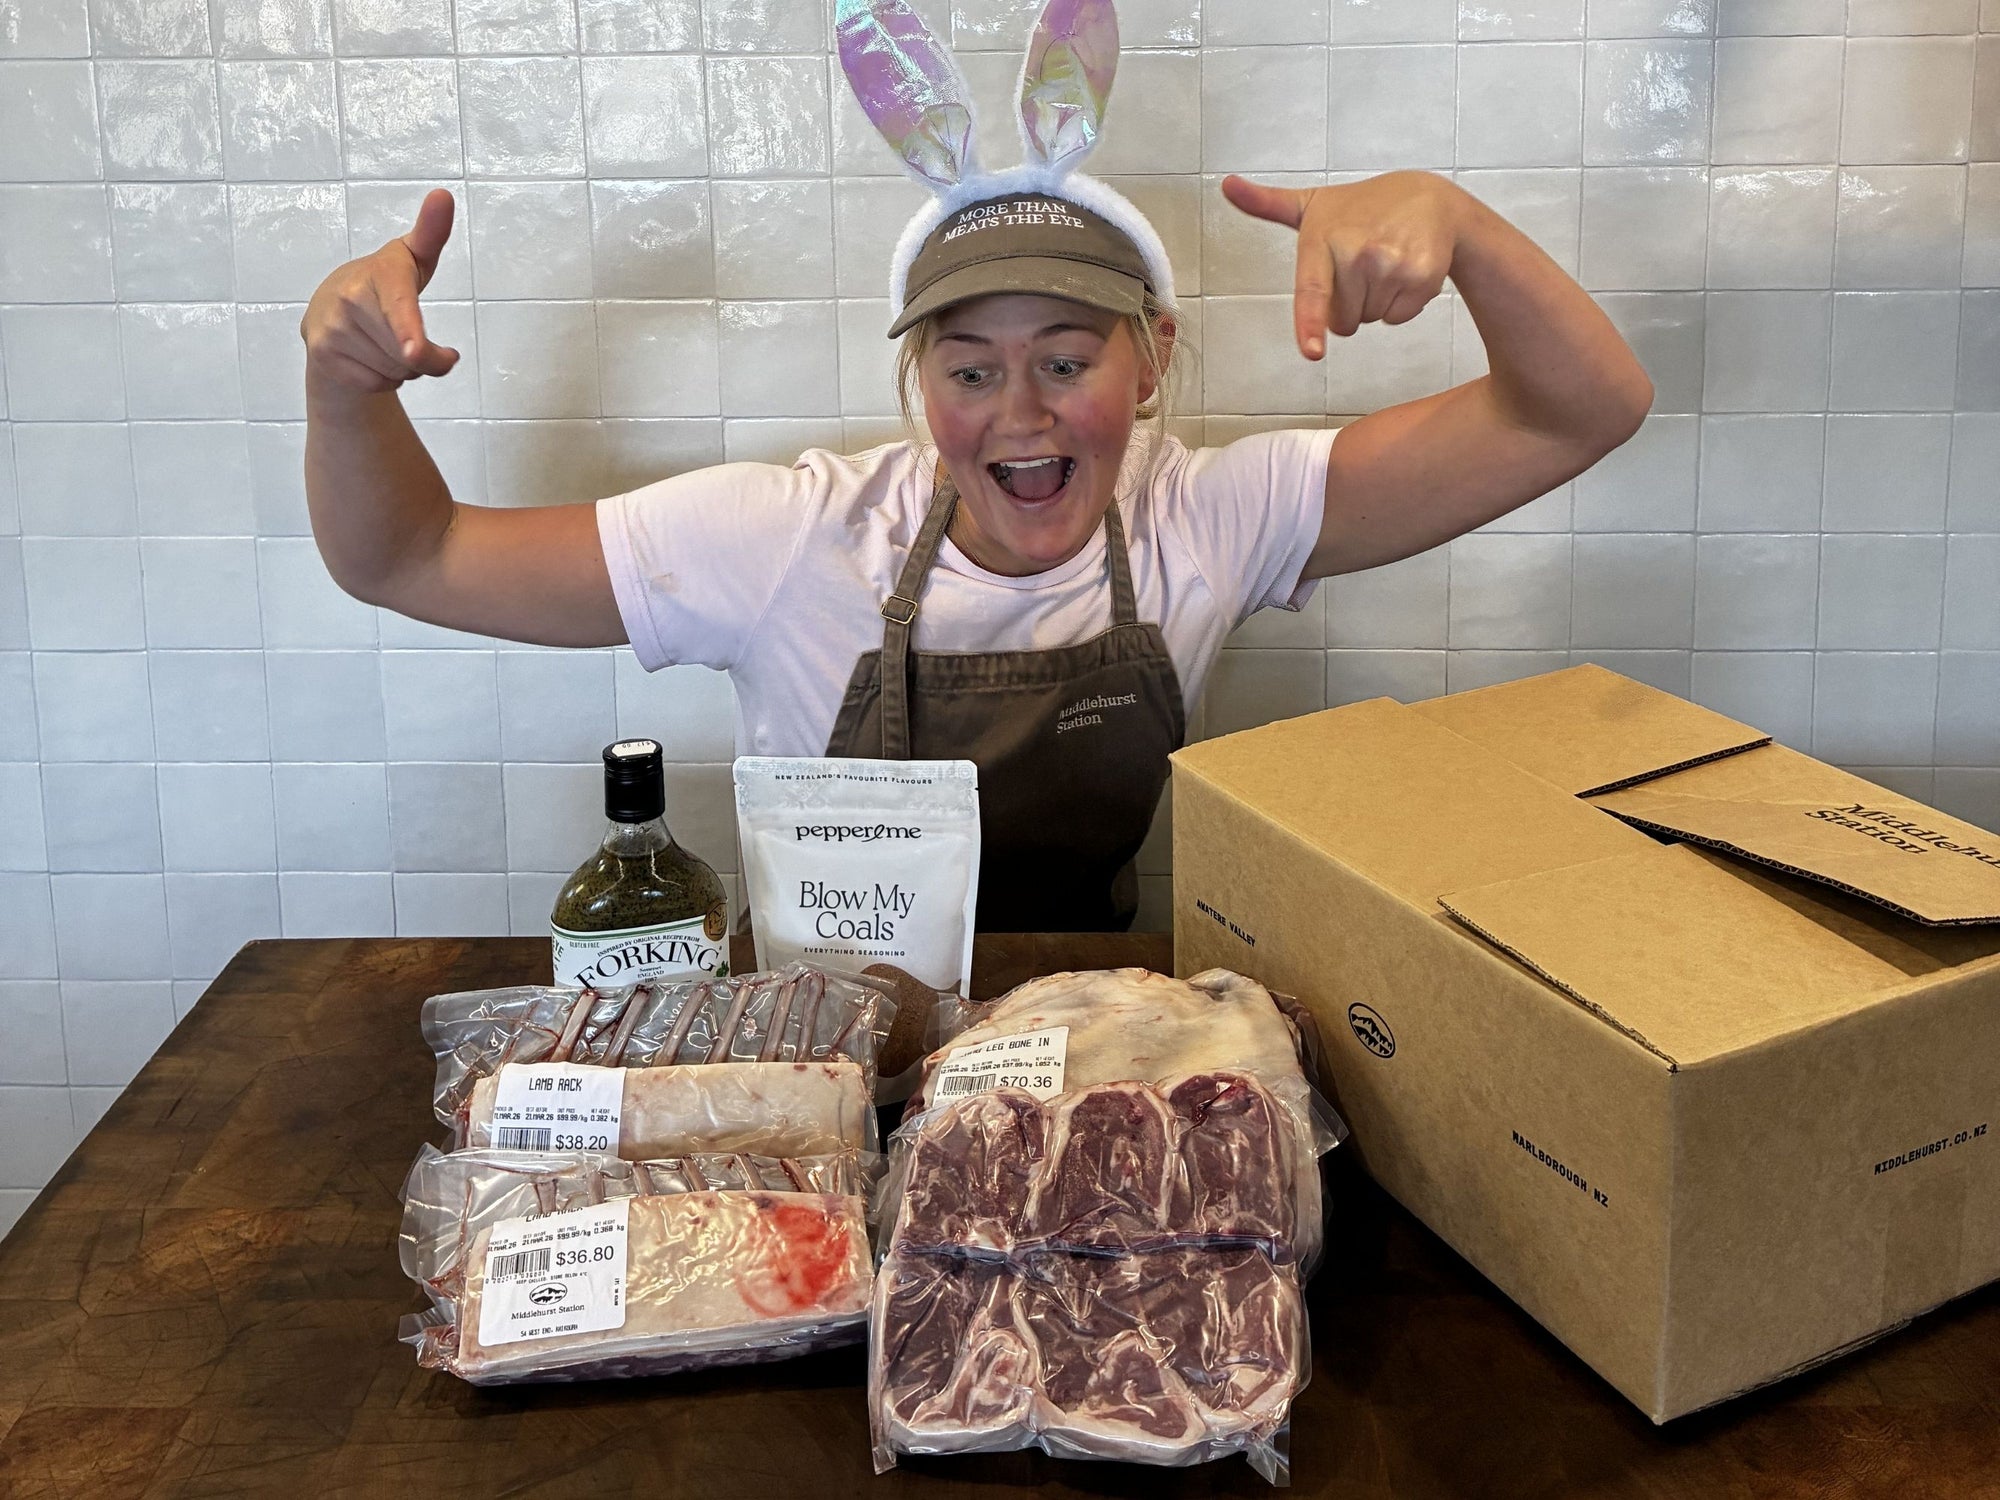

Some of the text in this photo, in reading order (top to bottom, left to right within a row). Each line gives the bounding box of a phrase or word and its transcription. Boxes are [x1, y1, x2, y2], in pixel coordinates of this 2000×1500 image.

[958, 201, 1067, 225] MORE THAN
[942, 214, 1084, 243] MEATS THE EYE
[1059, 693, 1136, 720] Middlehurst
[1057, 714, 1102, 734] Station
[844, 774, 888, 782] FAVOURITE
[891, 777, 933, 785] FLAVOURS
[1804, 809, 1928, 855] Station
[799, 880, 916, 919] Blow My
[816, 911, 894, 941] Coals
[1196, 898, 1255, 948] AWATERE VALLEY
[597, 943, 624, 957] INSPIRED
[633, 935, 661, 944] ORIGINAL
[804, 947, 905, 957] EVERYTHING SEASONING
[574, 940, 719, 989] FORKING
[986, 1037, 1050, 1052] LEG BONE IN
[528, 1078, 583, 1092] LAMB RACK
[1000, 1076, 1052, 1088] $70.36
[555, 1135, 608, 1150] $38.20
[1874, 1123, 1987, 1175] MIDDLEHURST.CO.NZ
[1512, 1130, 1609, 1208] MARLBOROUGH NZ
[616, 1224, 625, 1232] kg
[555, 1245, 614, 1266] $36.80
[511, 1304, 585, 1320] Middlehurst Station
